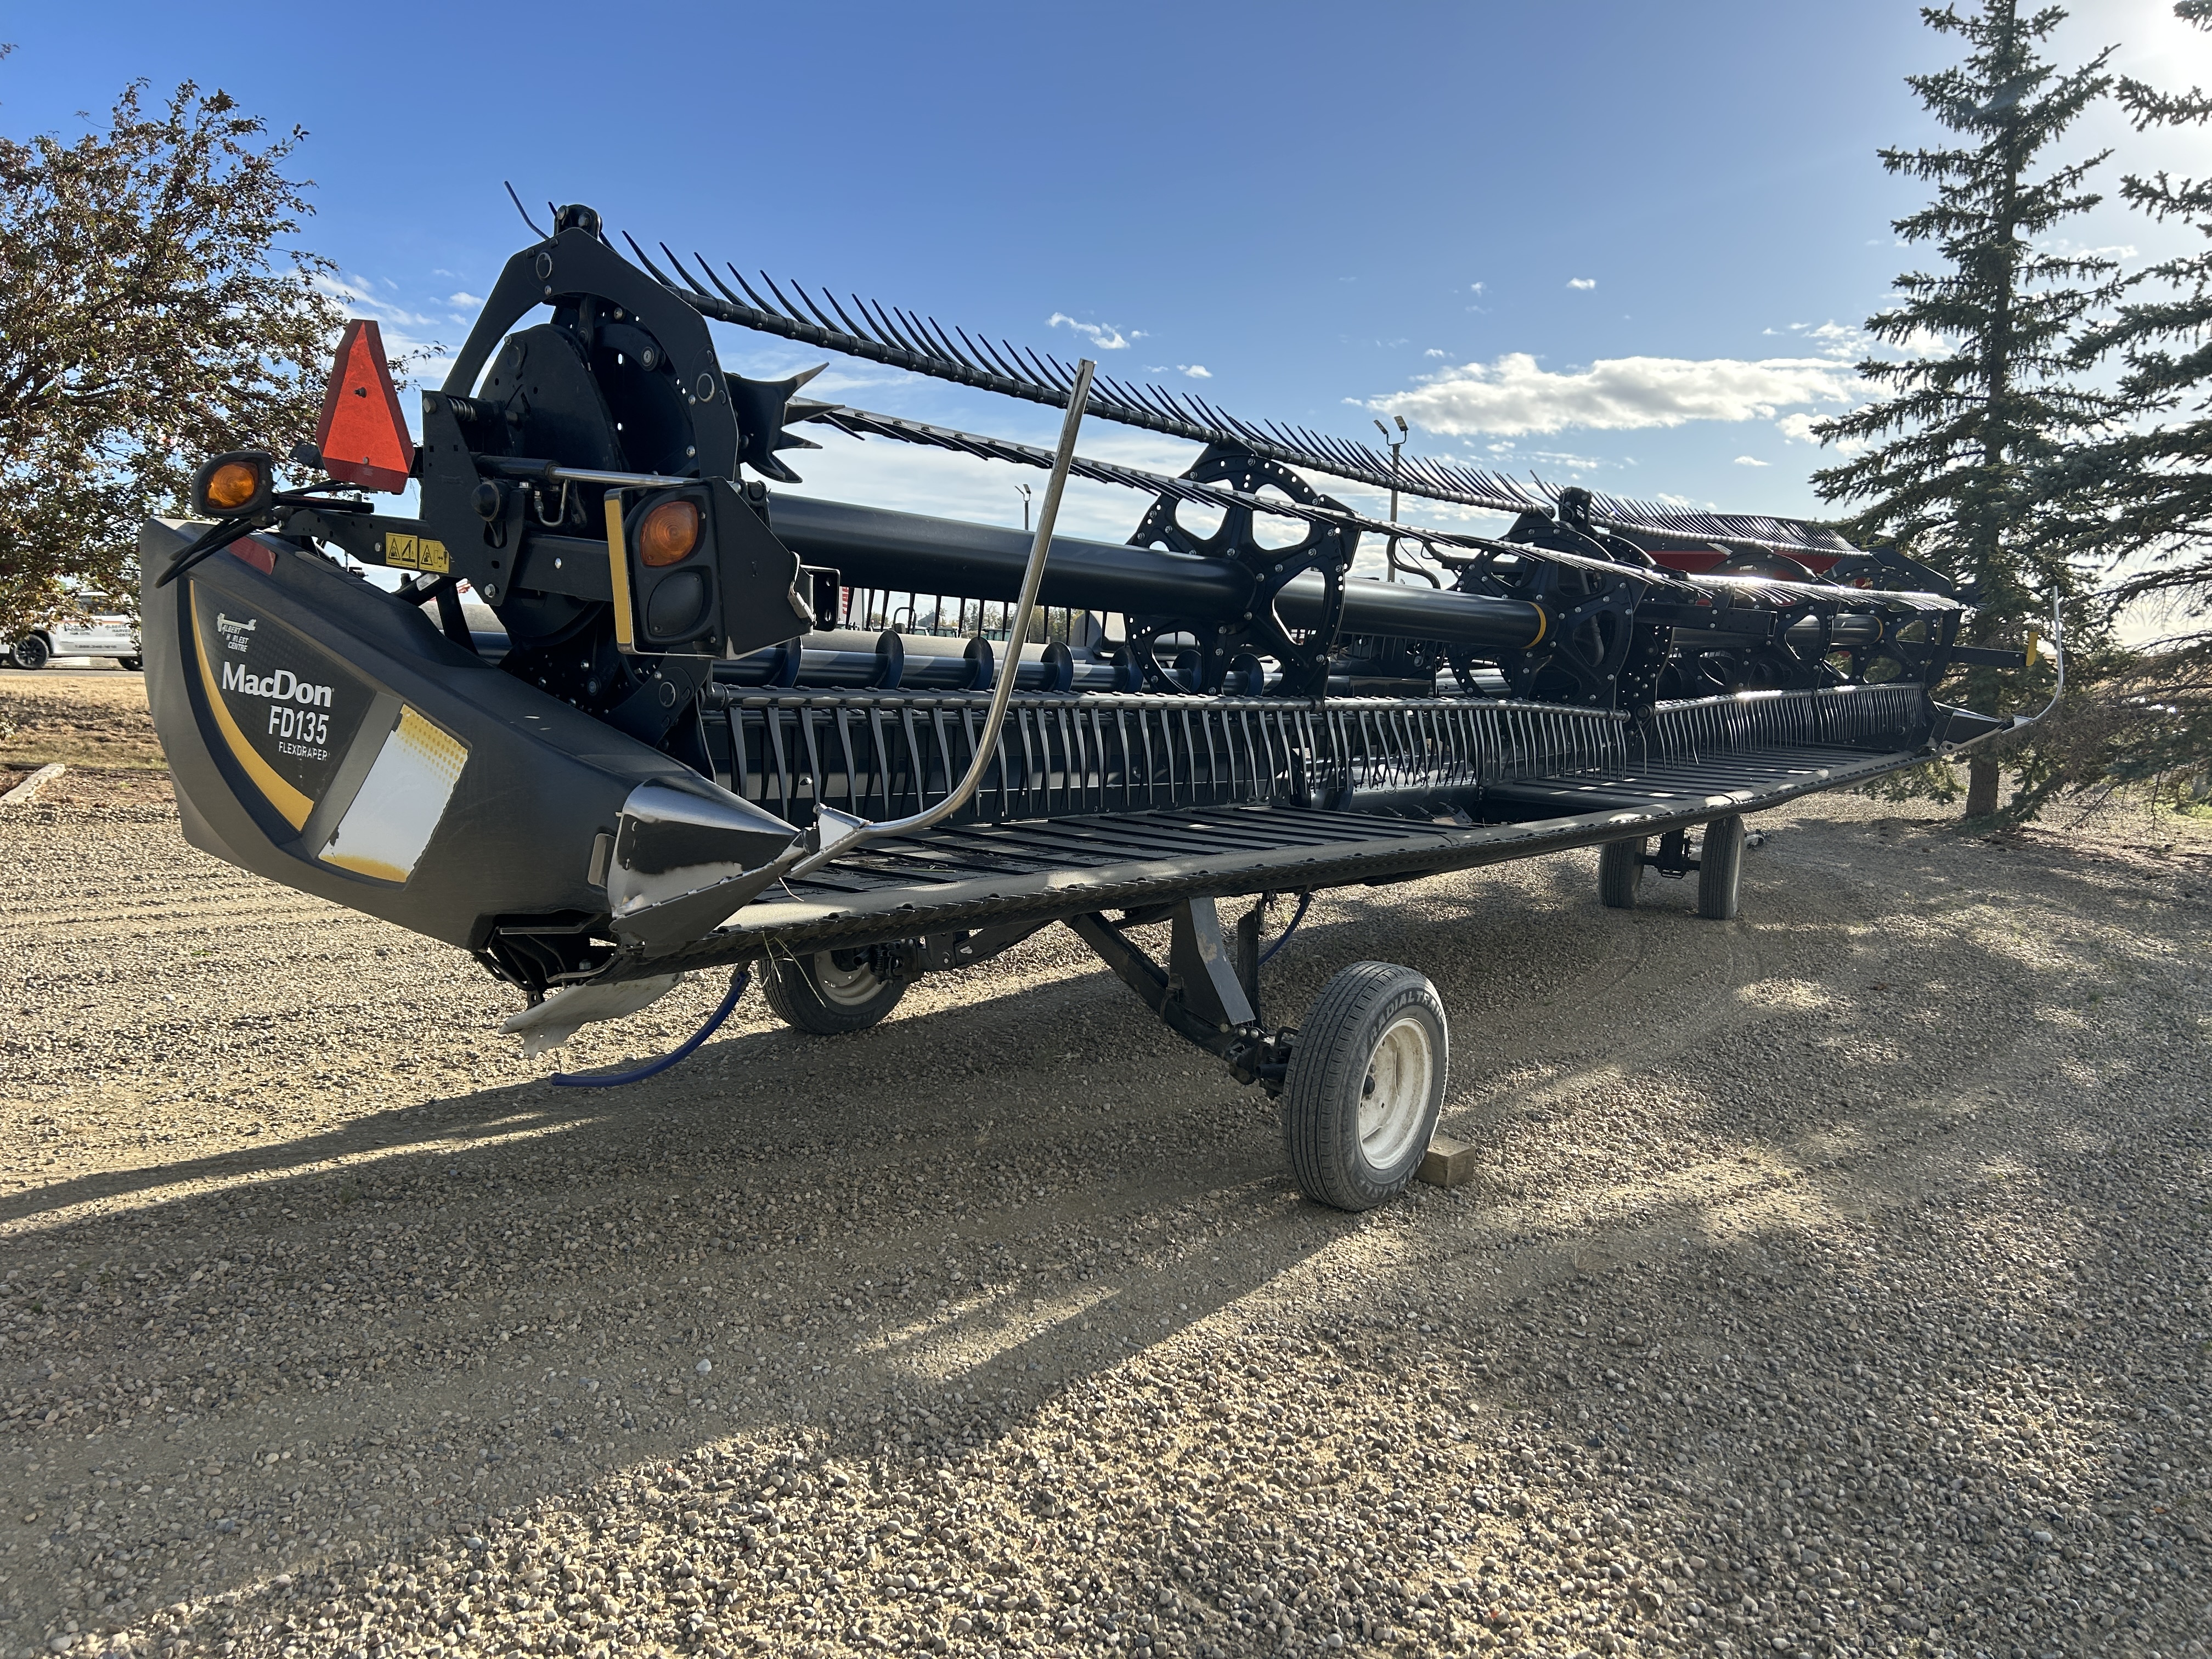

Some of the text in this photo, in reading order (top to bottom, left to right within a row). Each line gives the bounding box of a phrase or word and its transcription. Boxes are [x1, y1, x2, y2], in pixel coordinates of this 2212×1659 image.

[228, 641, 248, 652] CENTRE
[222, 661, 332, 708] MacDon
[268, 705, 329, 744] FD135
[278, 741, 328, 761] FLEXDRAPER
[1370, 991, 1414, 1045] RADIAL
